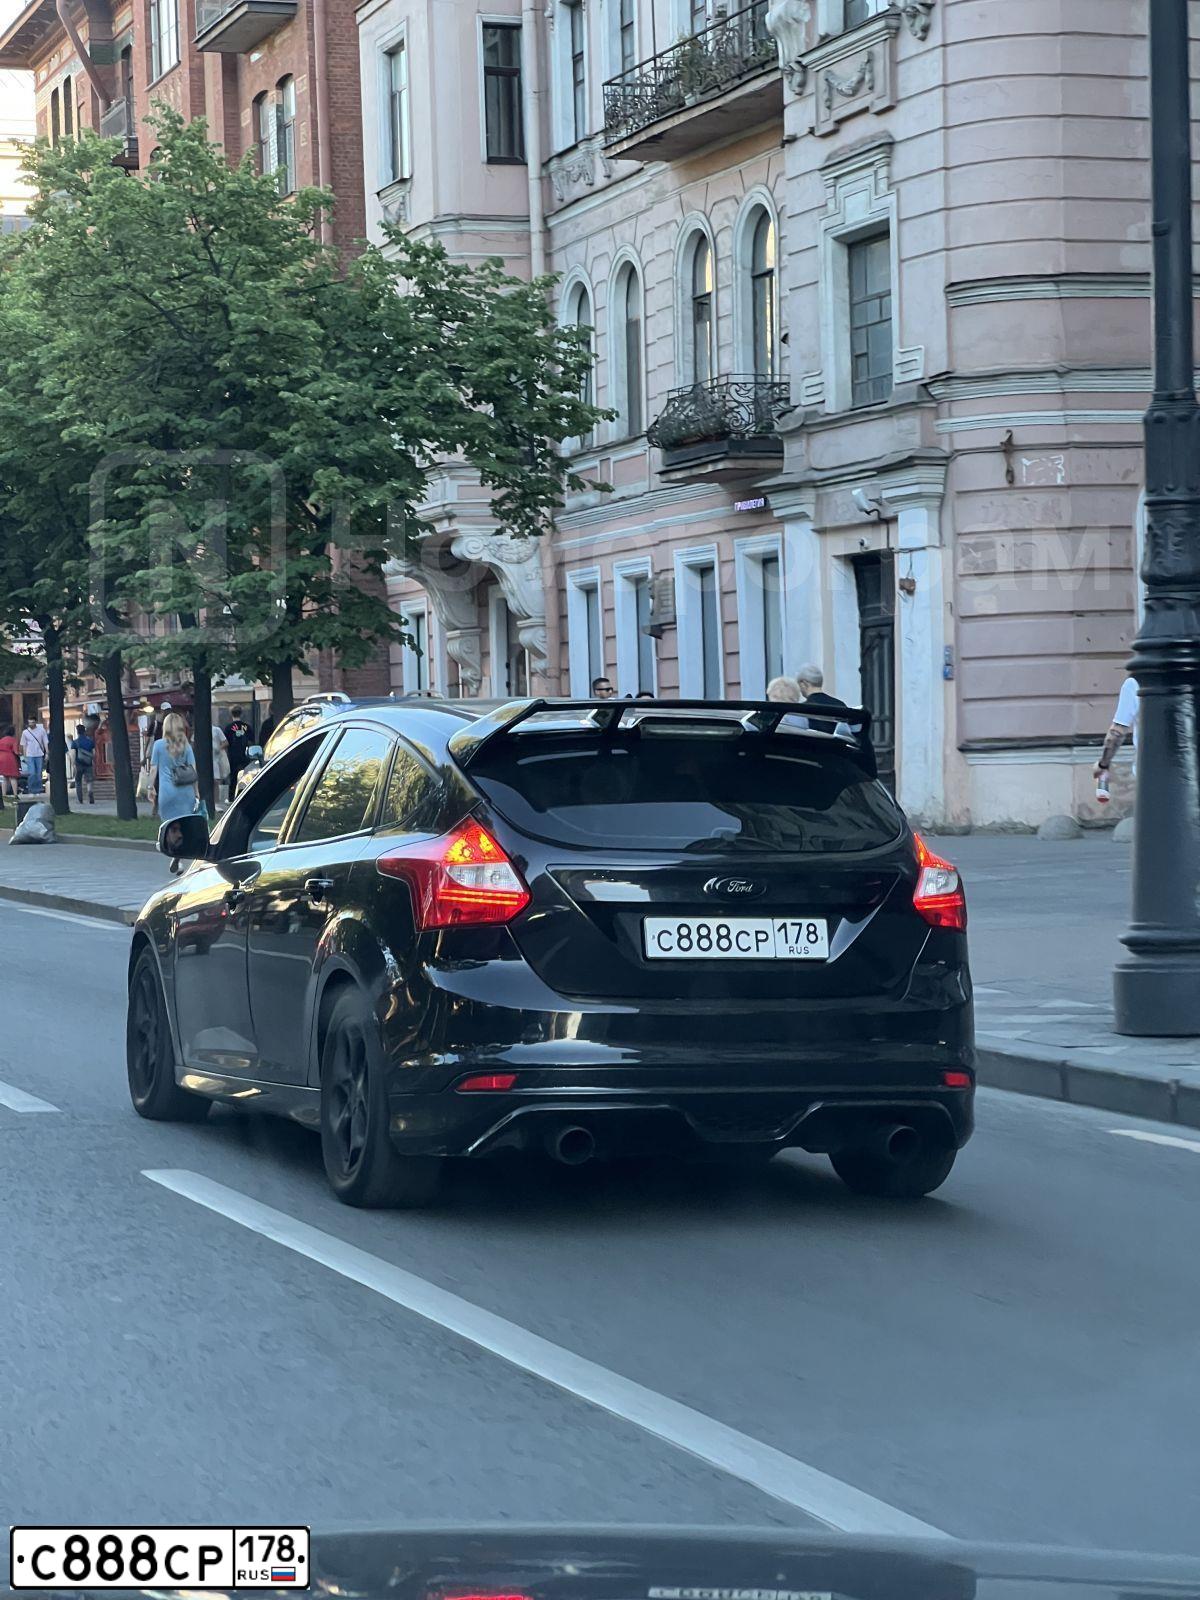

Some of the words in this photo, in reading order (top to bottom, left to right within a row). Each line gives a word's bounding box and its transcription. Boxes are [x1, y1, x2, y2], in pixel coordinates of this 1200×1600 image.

[727, 880, 753, 893] Ford
[776, 922, 819, 945] 178
[788, 946, 810, 955] RUS
